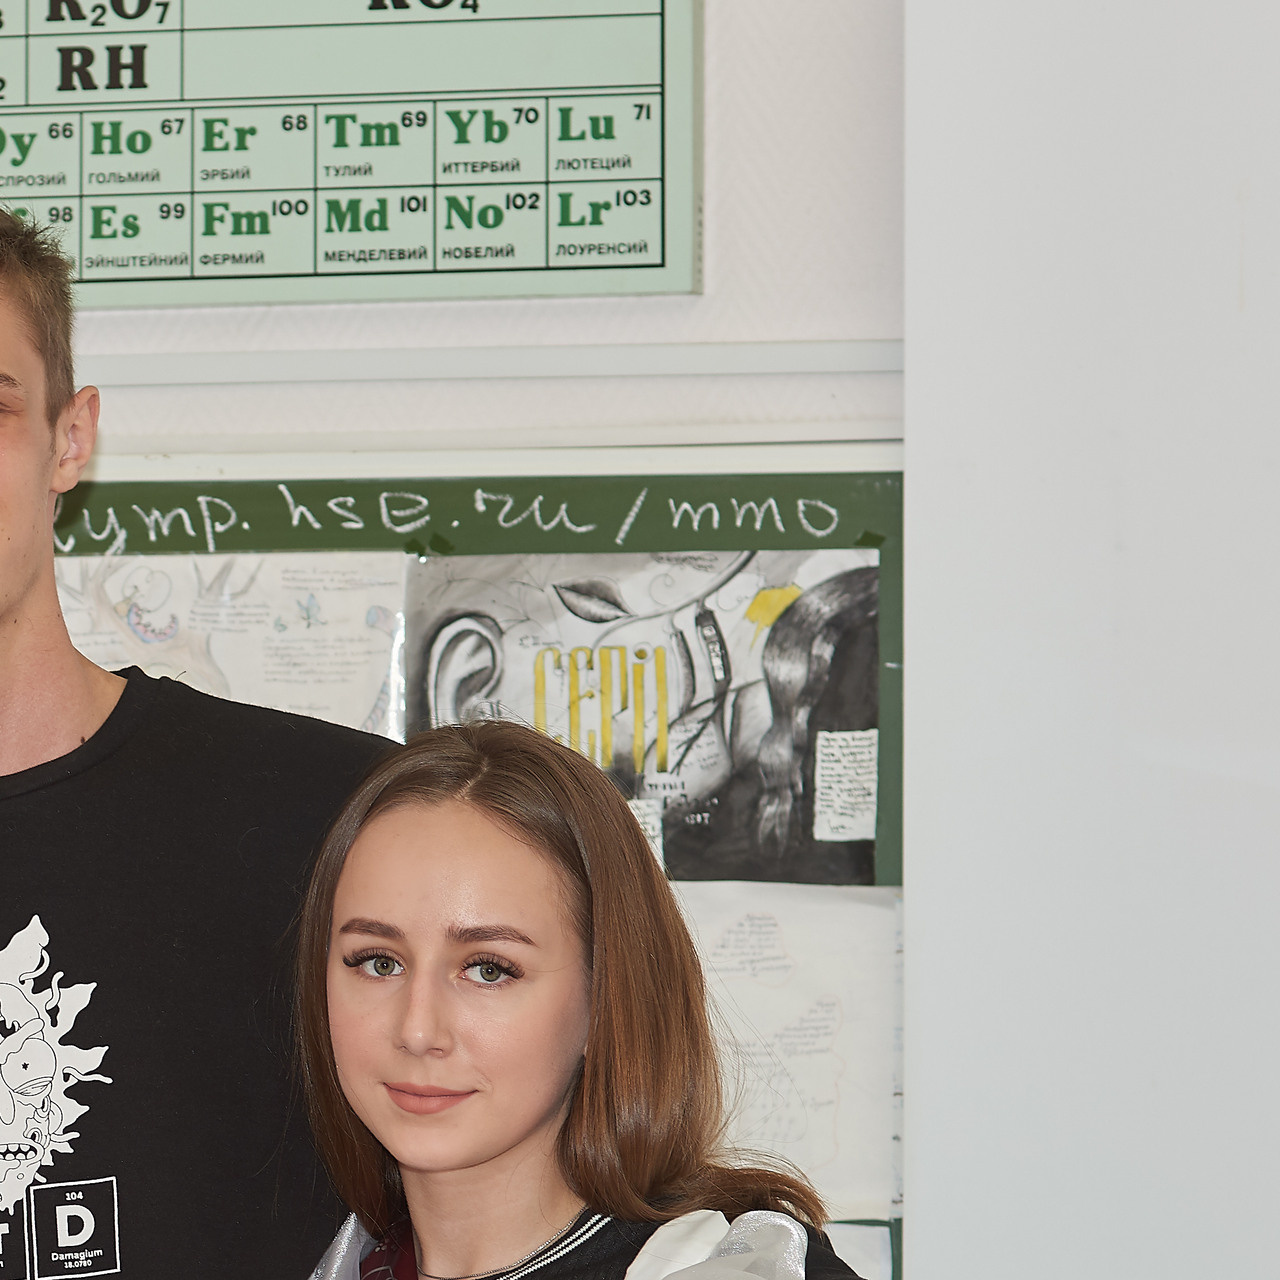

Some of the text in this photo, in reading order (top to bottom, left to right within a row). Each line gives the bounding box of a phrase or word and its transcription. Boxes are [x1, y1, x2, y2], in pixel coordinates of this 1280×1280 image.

[57, 44, 148, 91] RH
[325, 111, 427, 148] Tm 69
[445, 107, 539, 144] Yb 70
[558, 104, 651, 141] Lu 71
[48, 123, 74, 139] 66
[91, 118, 185, 155] Ho 67
[202, 114, 308, 152] Er 68
[324, 164, 373, 177] ТУЛИЙ
[442, 158, 521, 174] ИТТЕРБИЙ
[555, 156, 631, 172] ЛЮТЕЦИЙ
[88, 169, 160, 184] ГОЛЬМИЙ
[200, 166, 251, 180] ЭРБИЙ
[49, 207, 74, 223] 98
[325, 196, 427, 233] Md 101
[445, 193, 540, 230] No 102
[557, 190, 652, 227] Lr 103
[90, 203, 185, 239] Es 99
[202, 199, 309, 236] Fm 100
[324, 246, 428, 263] МЕНДЕЛЕВИЙ
[442, 243, 515, 259] НОБЕЛИЙ
[556, 241, 648, 257] ЛОУРЕНСИЙ
[85, 252, 188, 268] ЭЙНШТЕЙНИЙ
[200, 251, 265, 265] ФЕРМИЙ
[65, 1191, 84, 1201] 104
[51, 1249, 103, 1262] Damagium
